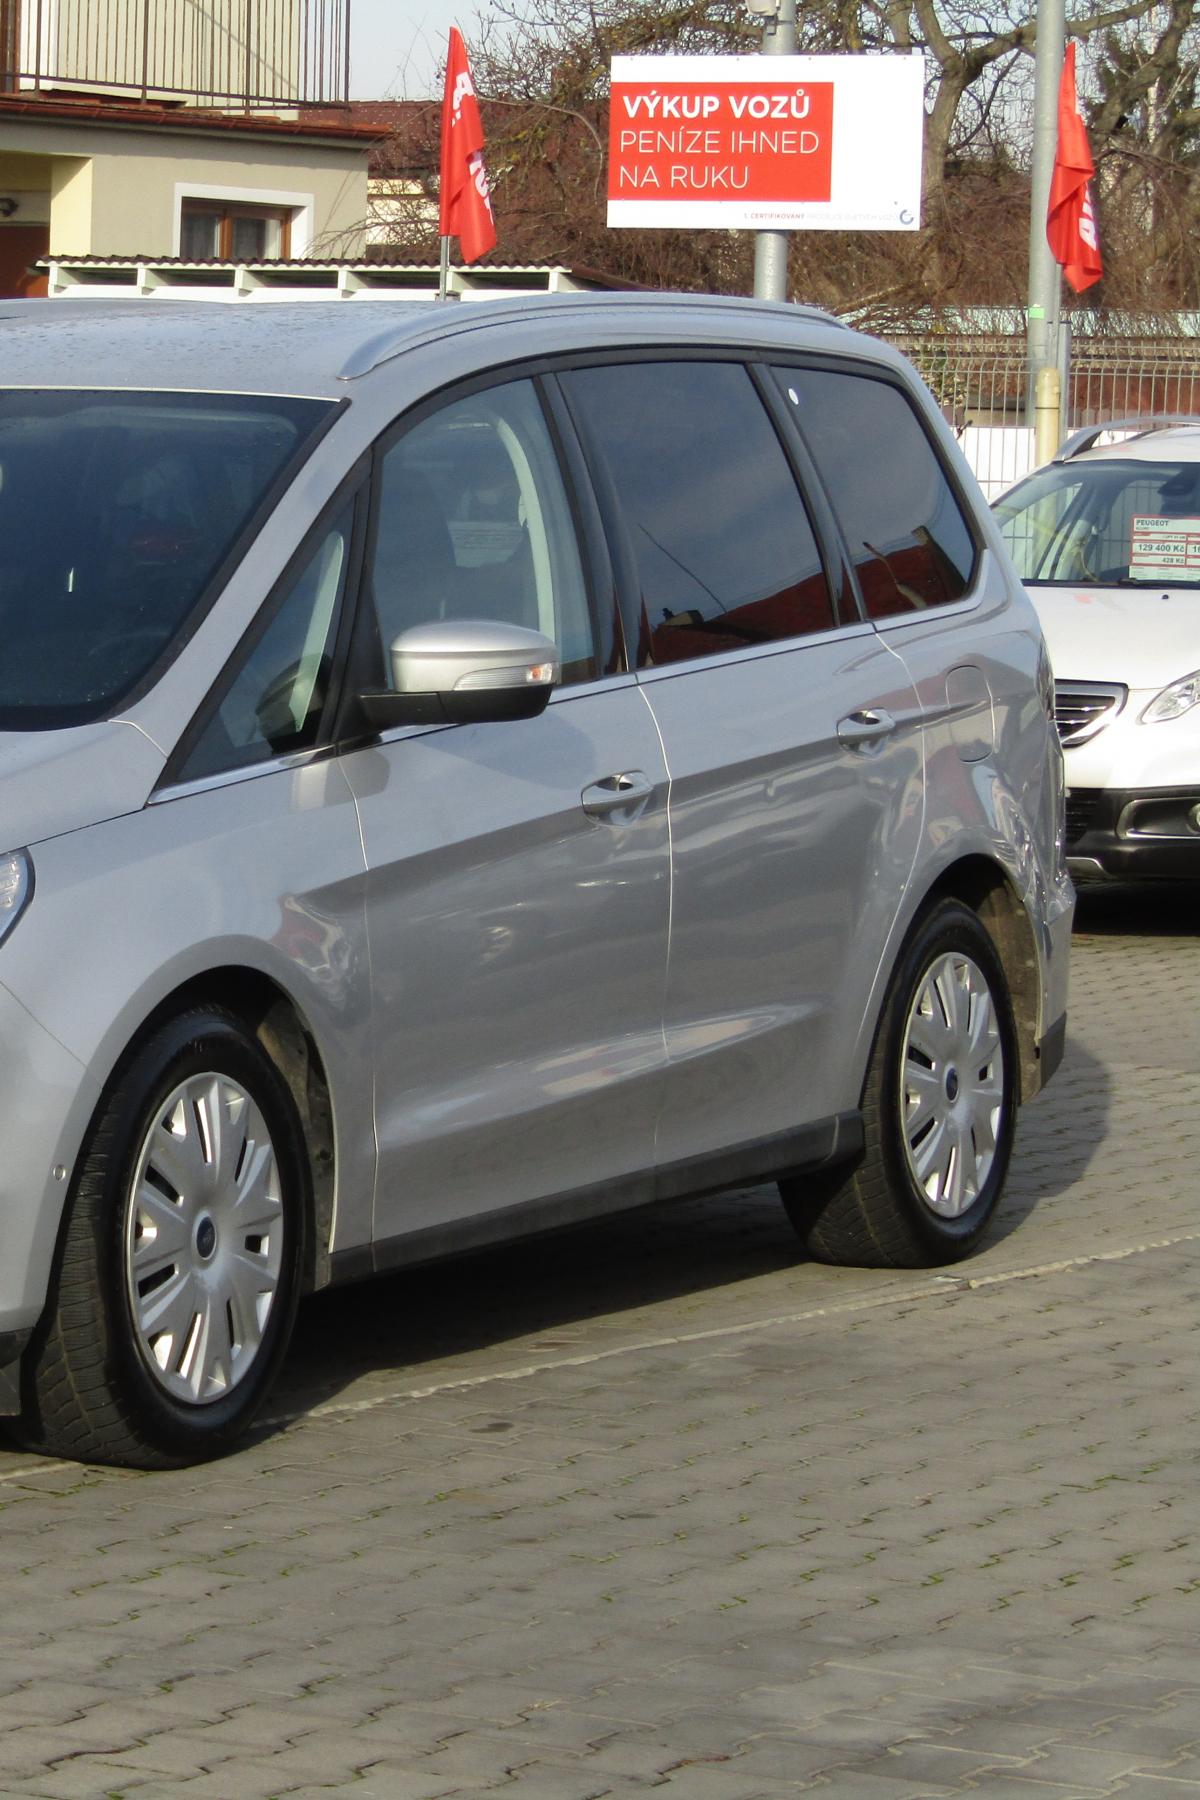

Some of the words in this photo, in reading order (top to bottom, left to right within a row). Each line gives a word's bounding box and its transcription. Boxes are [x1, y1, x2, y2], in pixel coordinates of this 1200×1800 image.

[623, 90, 720, 118] VÝKUP
[729, 88, 810, 118] VOZŮ
[620, 126, 720, 153] PENÍZE
[731, 131, 819, 154] IHNED
[619, 165, 660, 188] NA
[671, 165, 749, 189] RUKU
[1136, 519, 1169, 527] PEUGEOT
[1138, 544, 1153, 552] 129
[1155, 544, 1171, 552] 400
[1173, 544, 1185, 553] Kč
